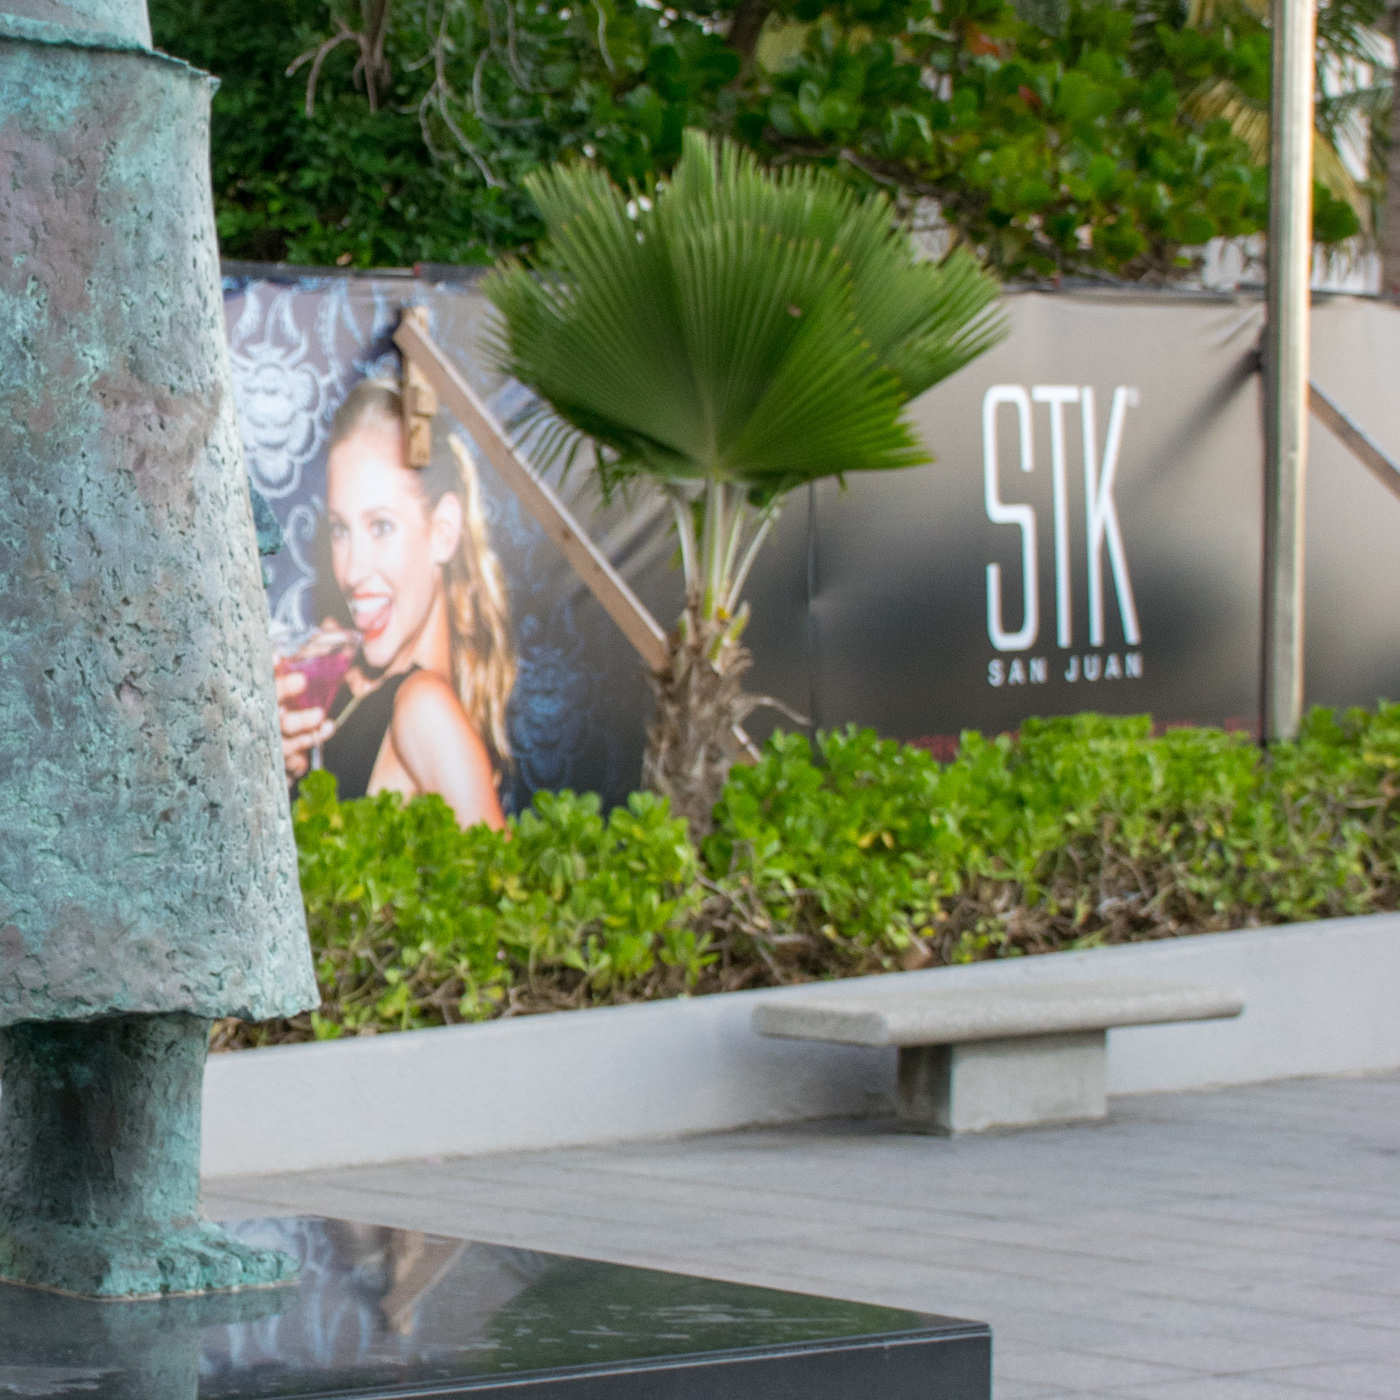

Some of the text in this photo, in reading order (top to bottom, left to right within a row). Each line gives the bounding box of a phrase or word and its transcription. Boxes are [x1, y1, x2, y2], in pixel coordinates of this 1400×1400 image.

[982, 385, 1141, 652] STK
[987, 652, 1144, 688] SAN JUAN
